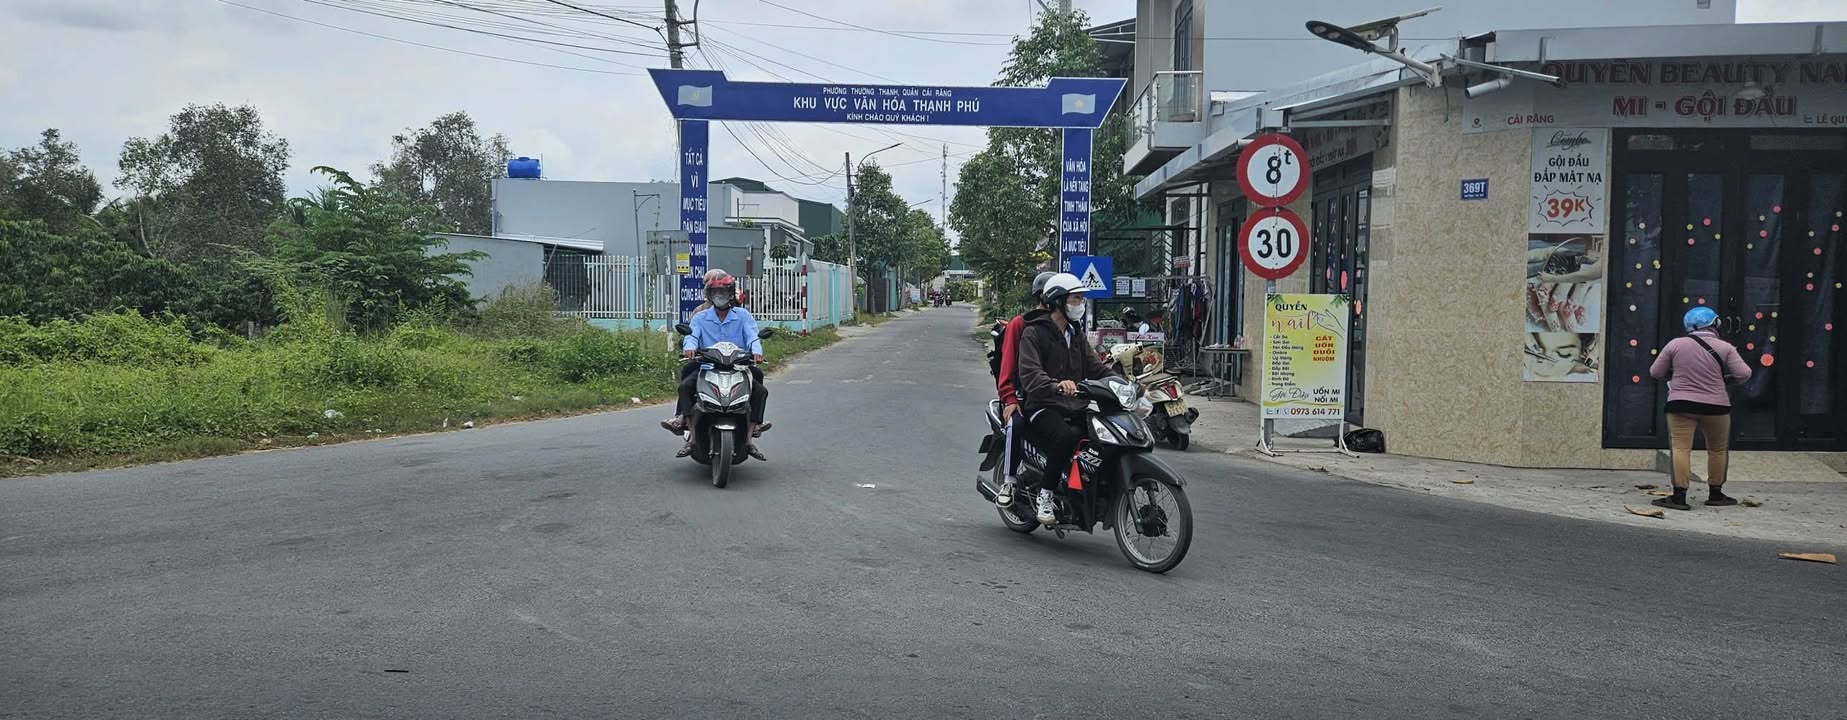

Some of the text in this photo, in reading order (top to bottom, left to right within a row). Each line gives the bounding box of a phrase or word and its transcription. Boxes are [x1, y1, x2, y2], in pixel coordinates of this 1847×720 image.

[1659, 62, 1788, 84] BEAUTY
[1800, 62, 1847, 84] NA
[922, 88, 932, 97] CÁI
[793, 95, 980, 113] KHU VỰC VĂN HÓA THẠNH PHÚ
[1612, 95, 1648, 117] MI
[1675, 88, 1728, 122] GỘI
[1732, 86, 1796, 118] ĐẦU
[847, 111, 863, 121] KÍNH
[864, 112, 885, 122] CHÀO
[901, 113, 924, 123] KHÁCH
[1527, 113, 1554, 123] RĂNG
[1831, 114, 1847, 125] QU
[1545, 130, 1593, 150] Combo
[685, 148, 703, 165] TẤT CẢ
[1548, 152, 1589, 169] GỘI ĐẦU
[1066, 157, 1086, 172] VĂN HÓA
[691, 171, 698, 188] VÌ
[1534, 167, 1602, 185] ĐẮP MẶT NẠ
[1064, 177, 1069, 192] LÀ
[1464, 182, 1486, 193] 369T
[683, 198, 694, 212] MỤC
[1064, 201, 1075, 212] TINH
[1547, 198, 1585, 218] 39K
[1073, 217, 1079, 232] XÃ
[1257, 228, 1291, 259] 30
[681, 285, 693, 300] CÔNG
[1271, 310, 1313, 333] nail
[1313, 386, 1329, 395] UỐN
